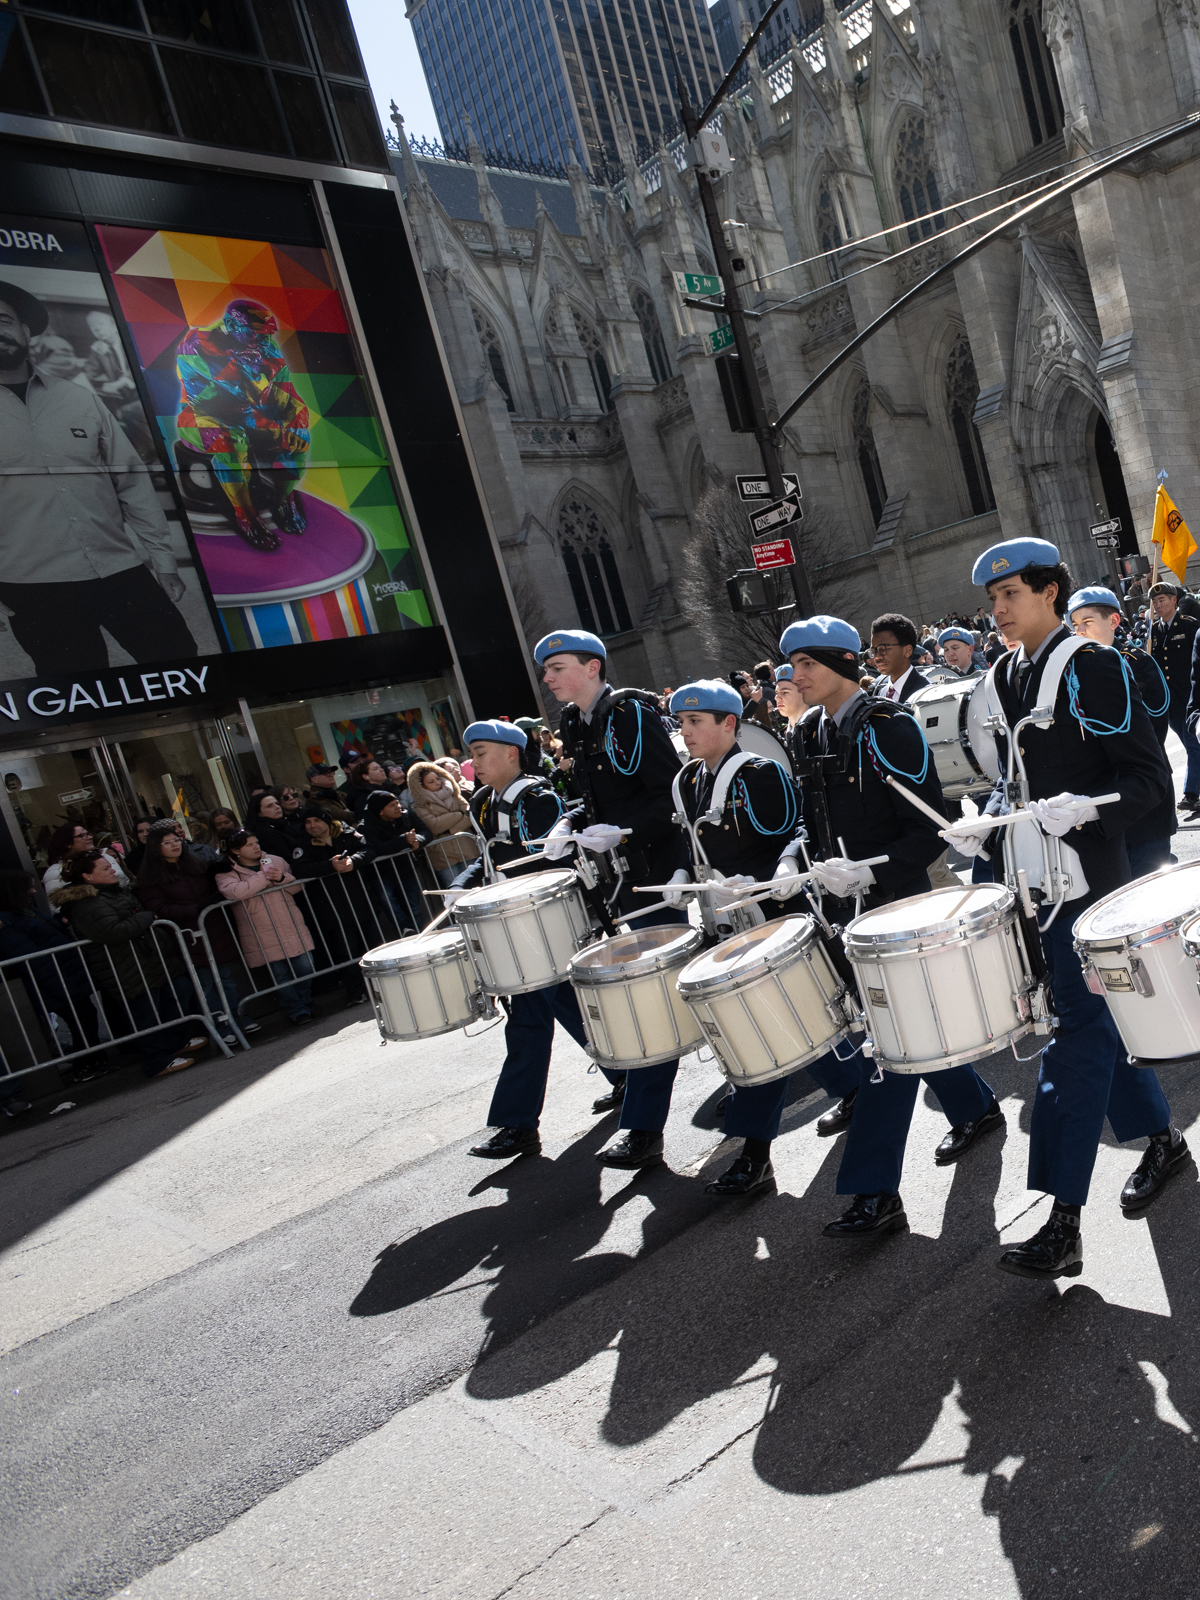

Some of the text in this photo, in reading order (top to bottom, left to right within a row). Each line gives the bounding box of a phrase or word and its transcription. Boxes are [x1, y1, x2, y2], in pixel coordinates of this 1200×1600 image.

[692, 276, 700, 292] 5
[709, 335, 716, 350] E
[716, 330, 726, 347] 51
[745, 482, 764, 493] ONE
[755, 504, 792, 529] ONE WAY
[761, 542, 785, 553] STANDING
[756, 550, 775, 559] Anytime
[27, 665, 209, 717] GALLERY
[1105, 972, 1123, 982] Pearl
